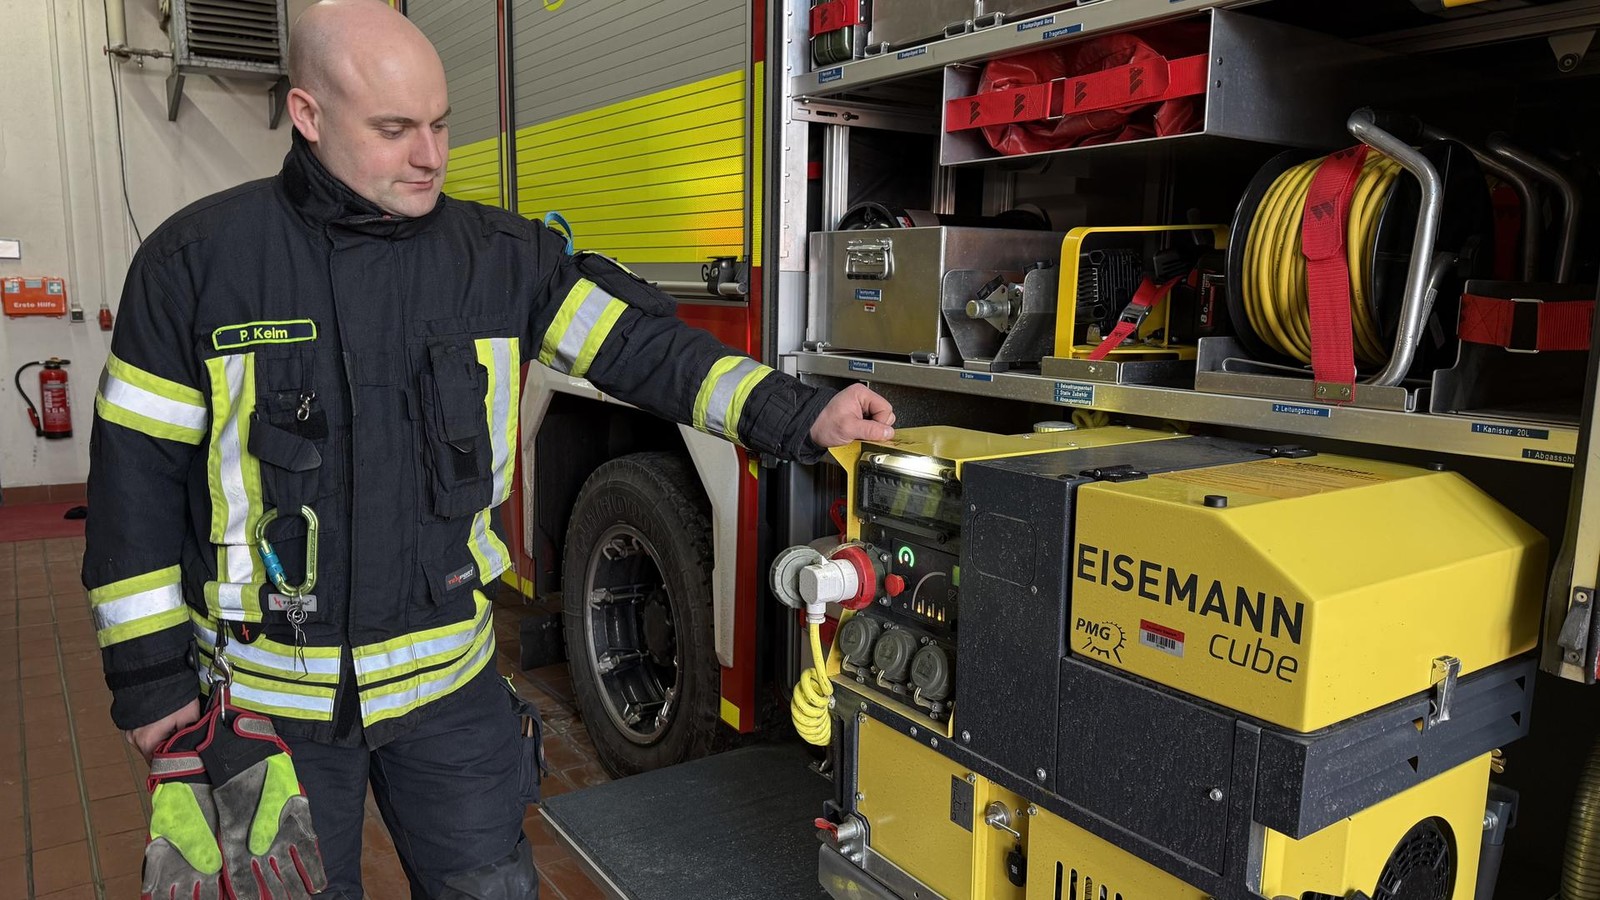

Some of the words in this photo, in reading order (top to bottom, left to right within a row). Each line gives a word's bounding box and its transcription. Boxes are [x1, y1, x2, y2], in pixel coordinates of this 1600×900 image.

[1281, 405, 1320, 415] Leitungsroller
[1483, 425, 1513, 435] Kanister
[1517, 429, 1530, 437] 20L
[1535, 451, 1575, 463] Abgasschl
[1077, 543, 1305, 645] EISEMANN
[1076, 617, 1111, 641] PMG
[1209, 634, 1299, 683] cube
